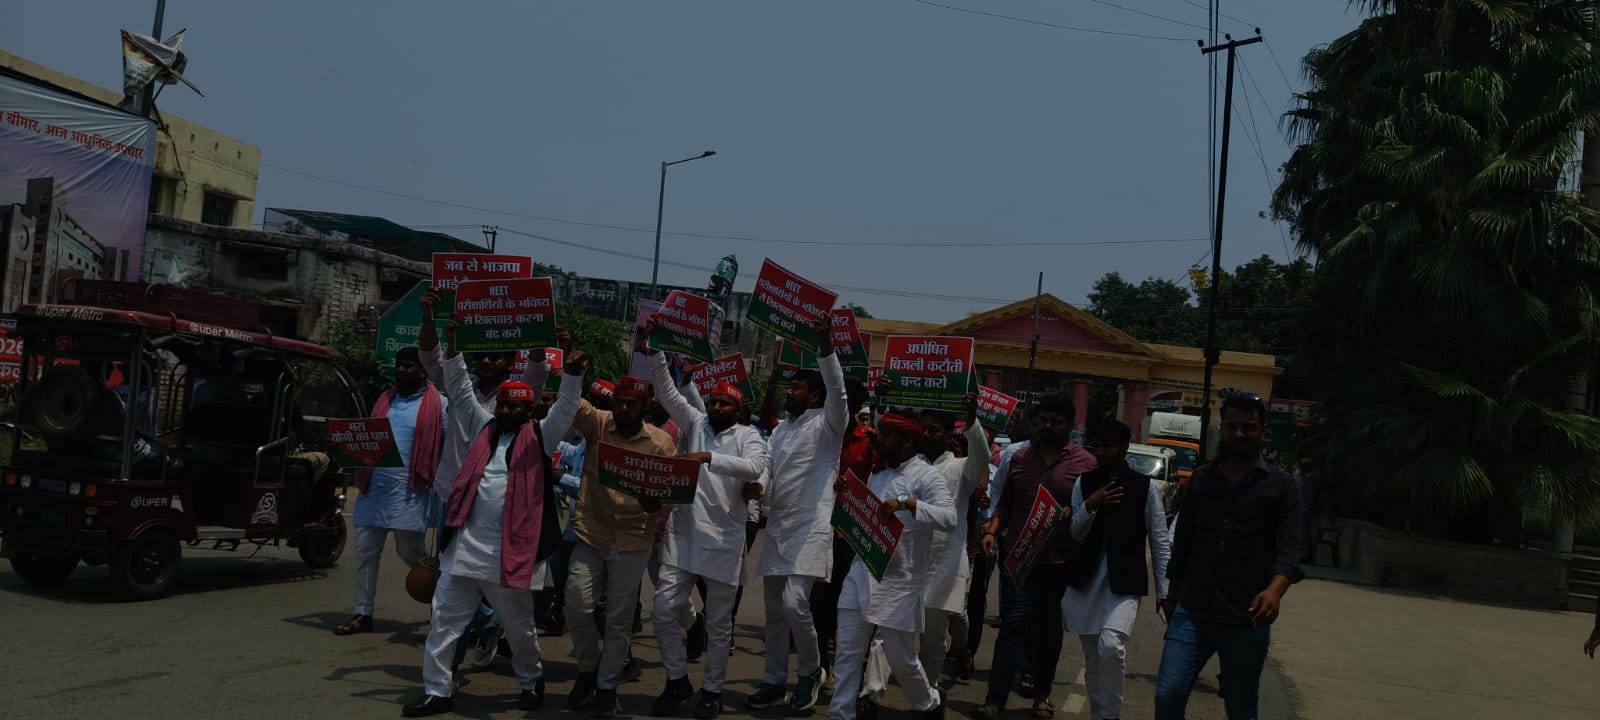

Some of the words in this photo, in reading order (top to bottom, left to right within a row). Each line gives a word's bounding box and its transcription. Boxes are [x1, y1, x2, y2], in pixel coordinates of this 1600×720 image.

[7, 111, 41, 134] बीमार,
[46, 123, 67, 139] आज
[71, 131, 112, 151] आधुनिक
[114, 144, 144, 159] उपचार
[443, 260, 463, 272] जब
[466, 257, 478, 273] से
[481, 261, 520, 273] भाजपा
[490, 285, 509, 296] NEET
[785, 279, 802, 294] NEET
[506, 298, 515, 308] के
[520, 297, 550, 308] भविष्य
[759, 292, 766, 304] से
[793, 293, 801, 307] के
[71, 308, 104, 321] Metro
[464, 315, 472, 325] से
[516, 313, 544, 323] करना
[484, 329, 499, 339] बंद
[501, 327, 522, 339] करो
[781, 319, 796, 333] करो
[224, 328, 254, 343] Metro
[905, 341, 949, 356] अघोषित
[890, 356, 924, 371] बिजली
[927, 358, 963, 373] कटौती
[900, 376, 921, 389] बन्द
[924, 374, 947, 389] करो
[331, 430, 354, 442] योगी
[355, 432, 369, 442] का
[370, 431, 390, 441] पाप
[346, 442, 360, 451] का
[623, 455, 674, 473] अघोषित
[604, 460, 645, 483] बिजली
[647, 474, 691, 488] कटौती
[619, 478, 642, 493] बन्द
[644, 485, 673, 498] करो
[130, 496, 168, 509] SUPER
